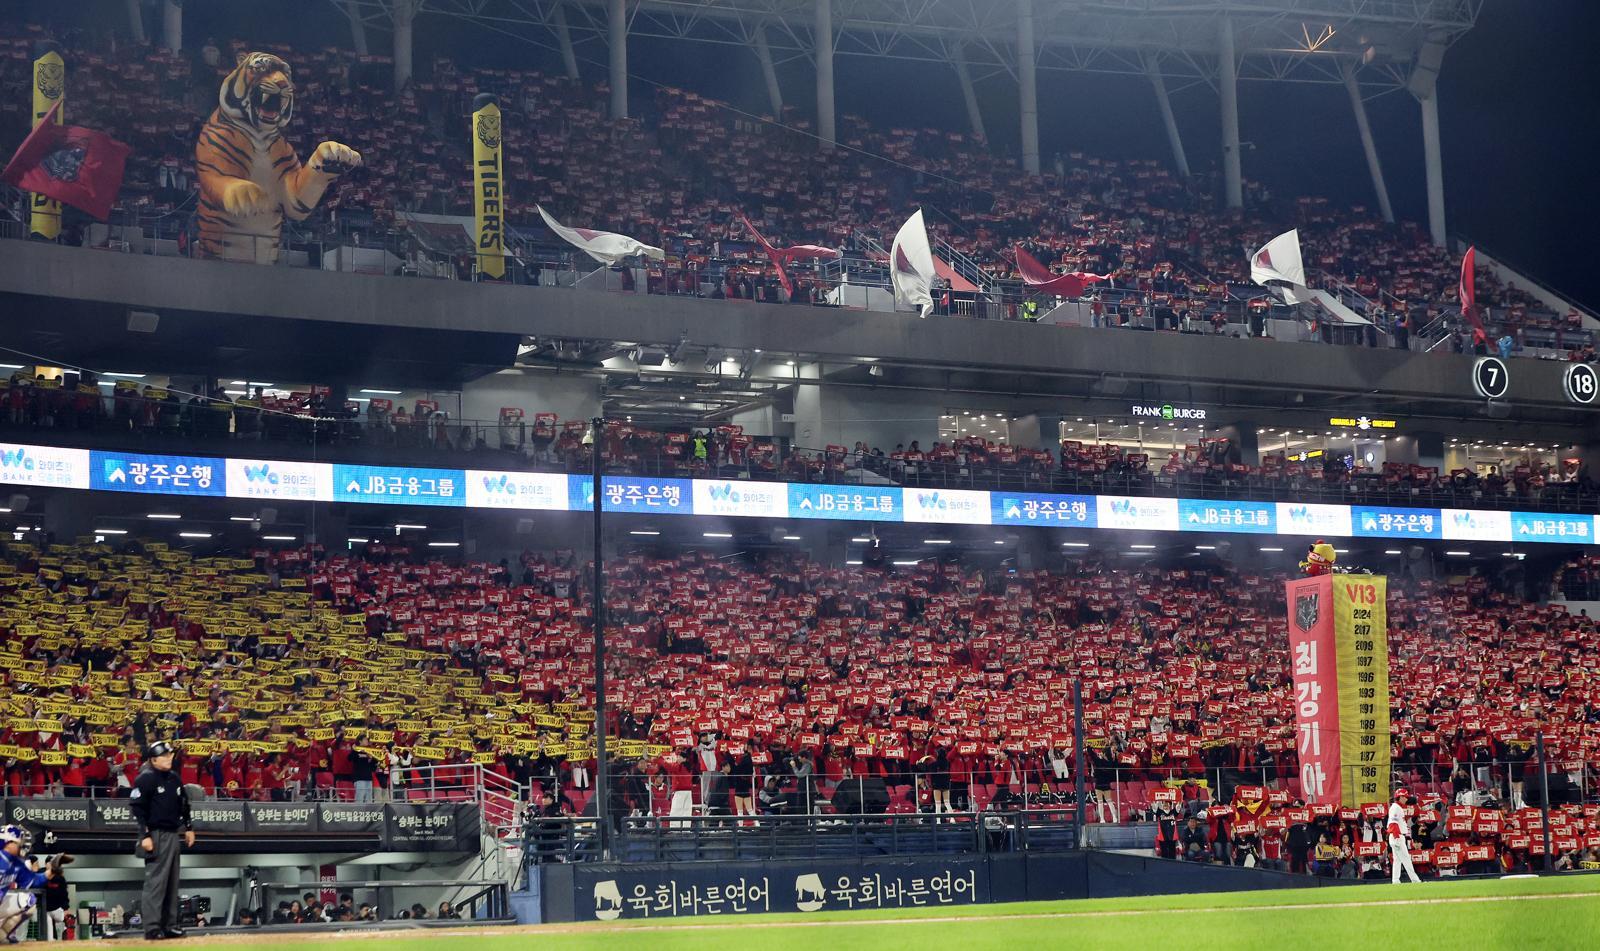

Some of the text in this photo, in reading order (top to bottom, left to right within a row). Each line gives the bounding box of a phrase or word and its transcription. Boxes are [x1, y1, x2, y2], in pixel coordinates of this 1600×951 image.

[478, 153, 500, 250] TIGERS
[1487, 368, 1499, 388] 7
[1573, 374, 1594, 394] 18
[1132, 405, 1206, 419] FRANK BURGER
[128, 462, 212, 489] 광주은행
[363, 475, 455, 497] JB금융그룹
[605, 484, 681, 507] 광주은행
[815, 493, 894, 513] JB금융그룹
[1022, 500, 1087, 522] 광주은행
[1201, 508, 1269, 527] JB금융그룹
[1378, 513, 1434, 533] 광주은행
[1530, 520, 1589, 537] JB금융그룹
[1345, 583, 1377, 605] V13
[1353, 609, 1371, 620] 2024
[1354, 624, 1371, 635] 2017
[26, 807, 87, 821] 센트럴윤길중안과
[333, 810, 384, 822] 센트럴윤길중안과
[626, 876, 770, 918] 육회바른연어
[831, 869, 976, 908] 육회바른연어
